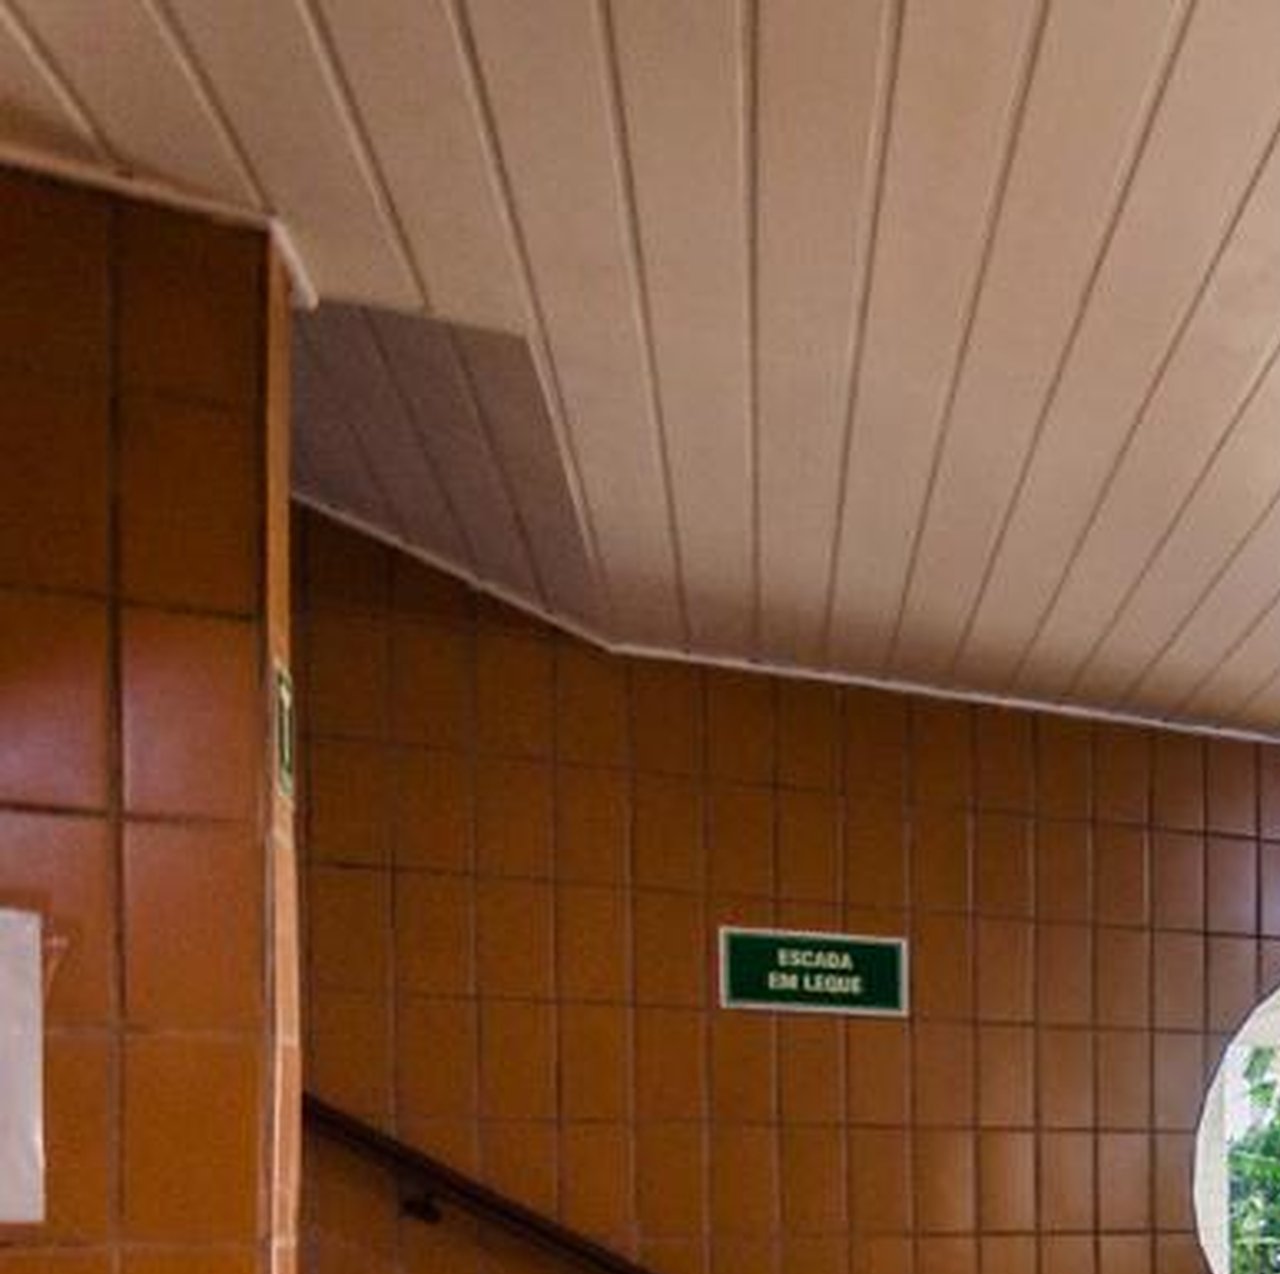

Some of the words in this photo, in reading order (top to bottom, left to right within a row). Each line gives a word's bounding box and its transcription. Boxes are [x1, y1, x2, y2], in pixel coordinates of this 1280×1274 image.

[777, 948, 853, 970] ESCADA
[769, 972, 798, 990] EM
[803, 973, 863, 994] LEQUE
